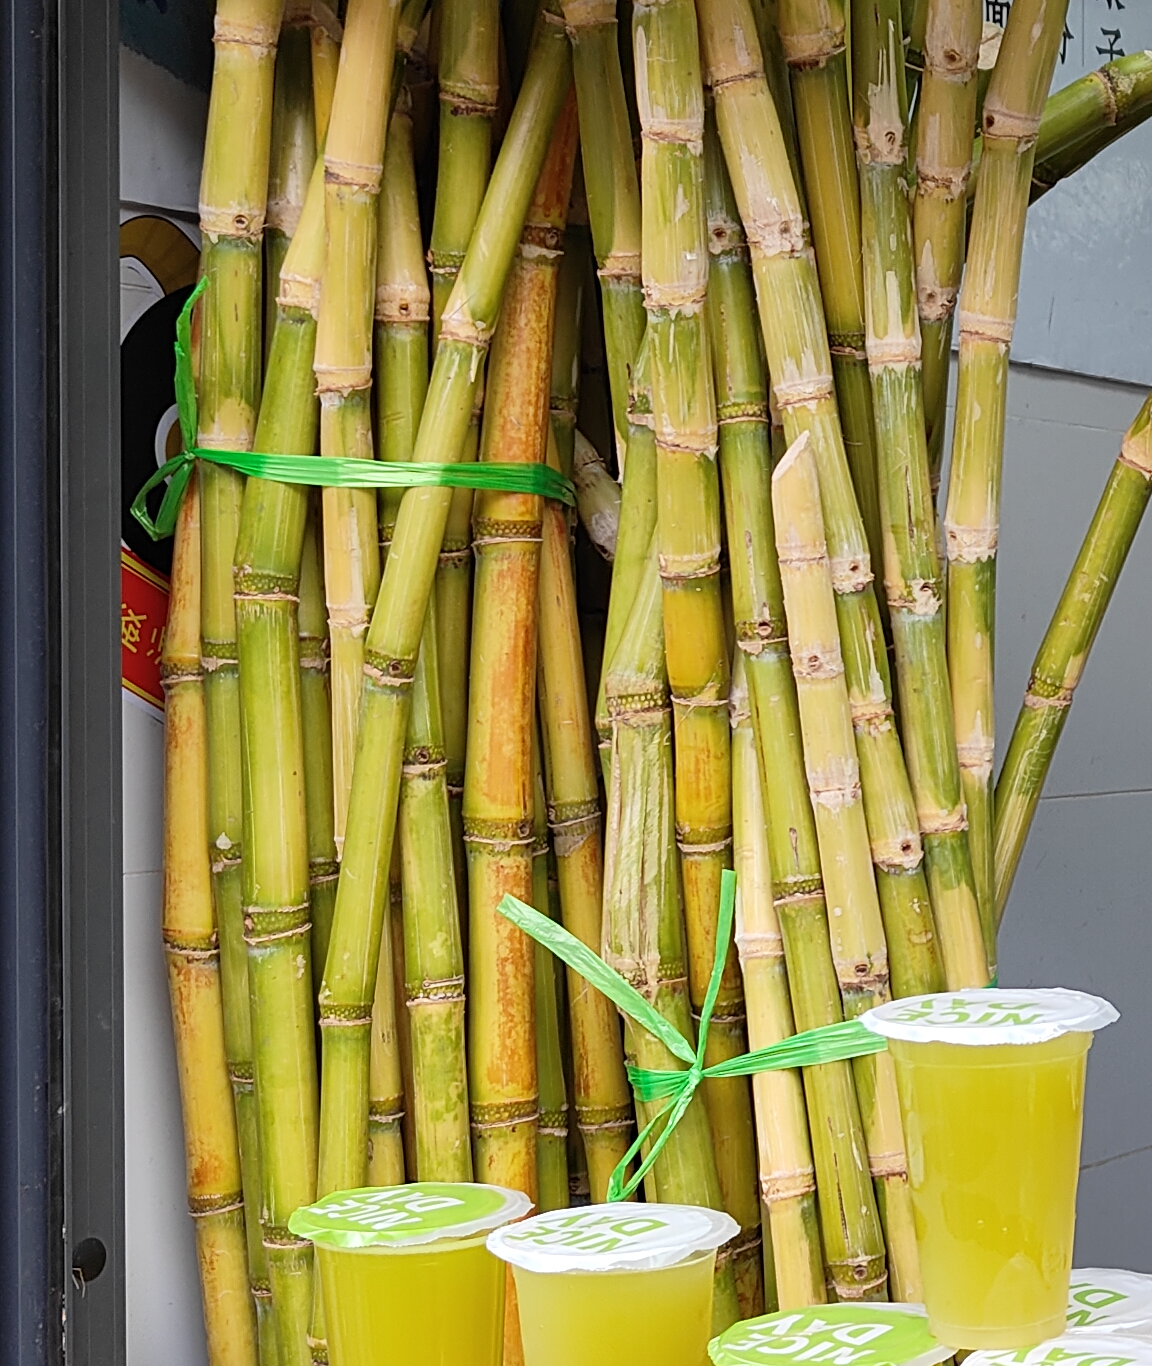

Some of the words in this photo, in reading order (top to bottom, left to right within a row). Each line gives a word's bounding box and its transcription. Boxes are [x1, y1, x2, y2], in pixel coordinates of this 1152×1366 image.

[308, 1198, 423, 1230] NICE
[351, 1188, 465, 1213] DAY
[505, 1225, 638, 1253] NICE
[537, 1212, 669, 1236] DAY
[747, 1314, 894, 1346] DAY
[723, 1333, 875, 1365] NICE
